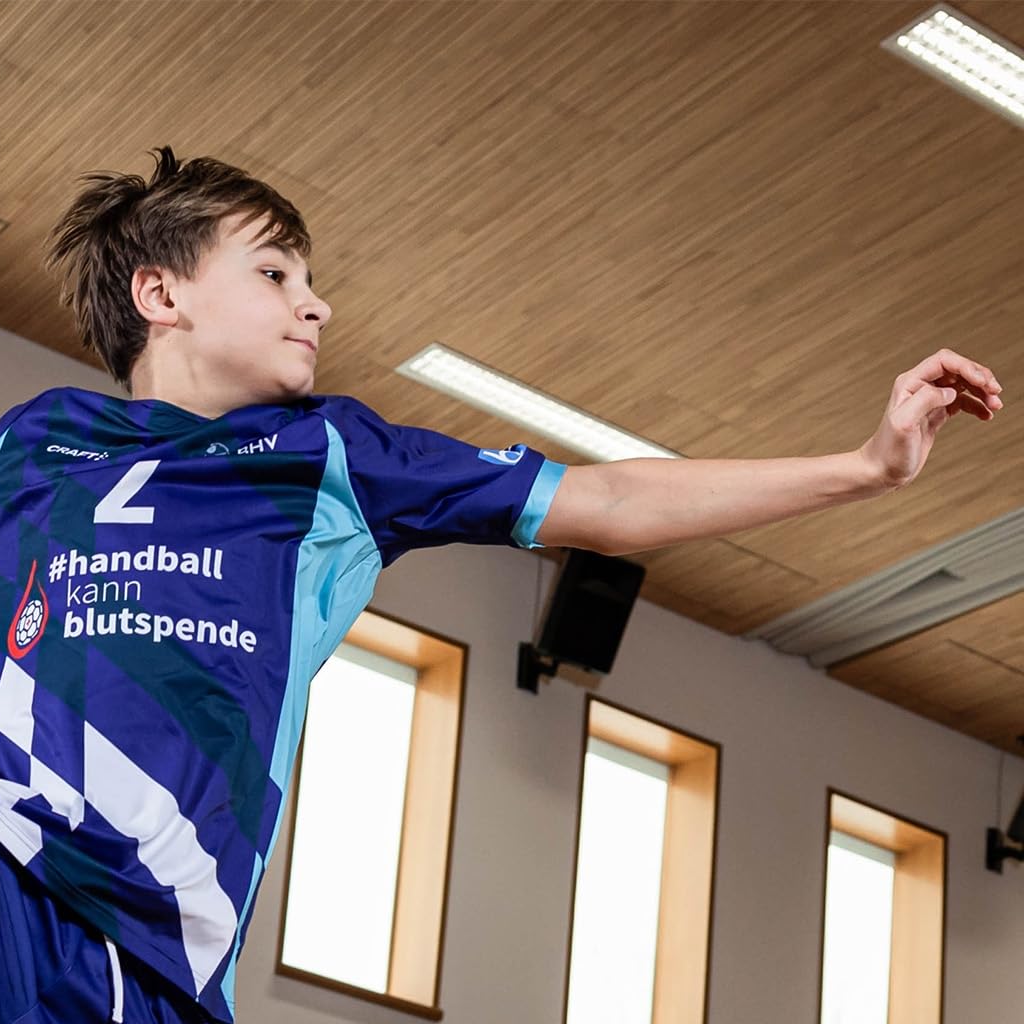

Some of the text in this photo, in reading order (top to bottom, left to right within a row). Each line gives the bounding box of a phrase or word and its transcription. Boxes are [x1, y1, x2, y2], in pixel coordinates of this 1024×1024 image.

[46, 445, 100, 460] CRAFT
[48, 545, 224, 584] #handball
[66, 578, 142, 608] kann
[63, 607, 258, 653] blutspende
